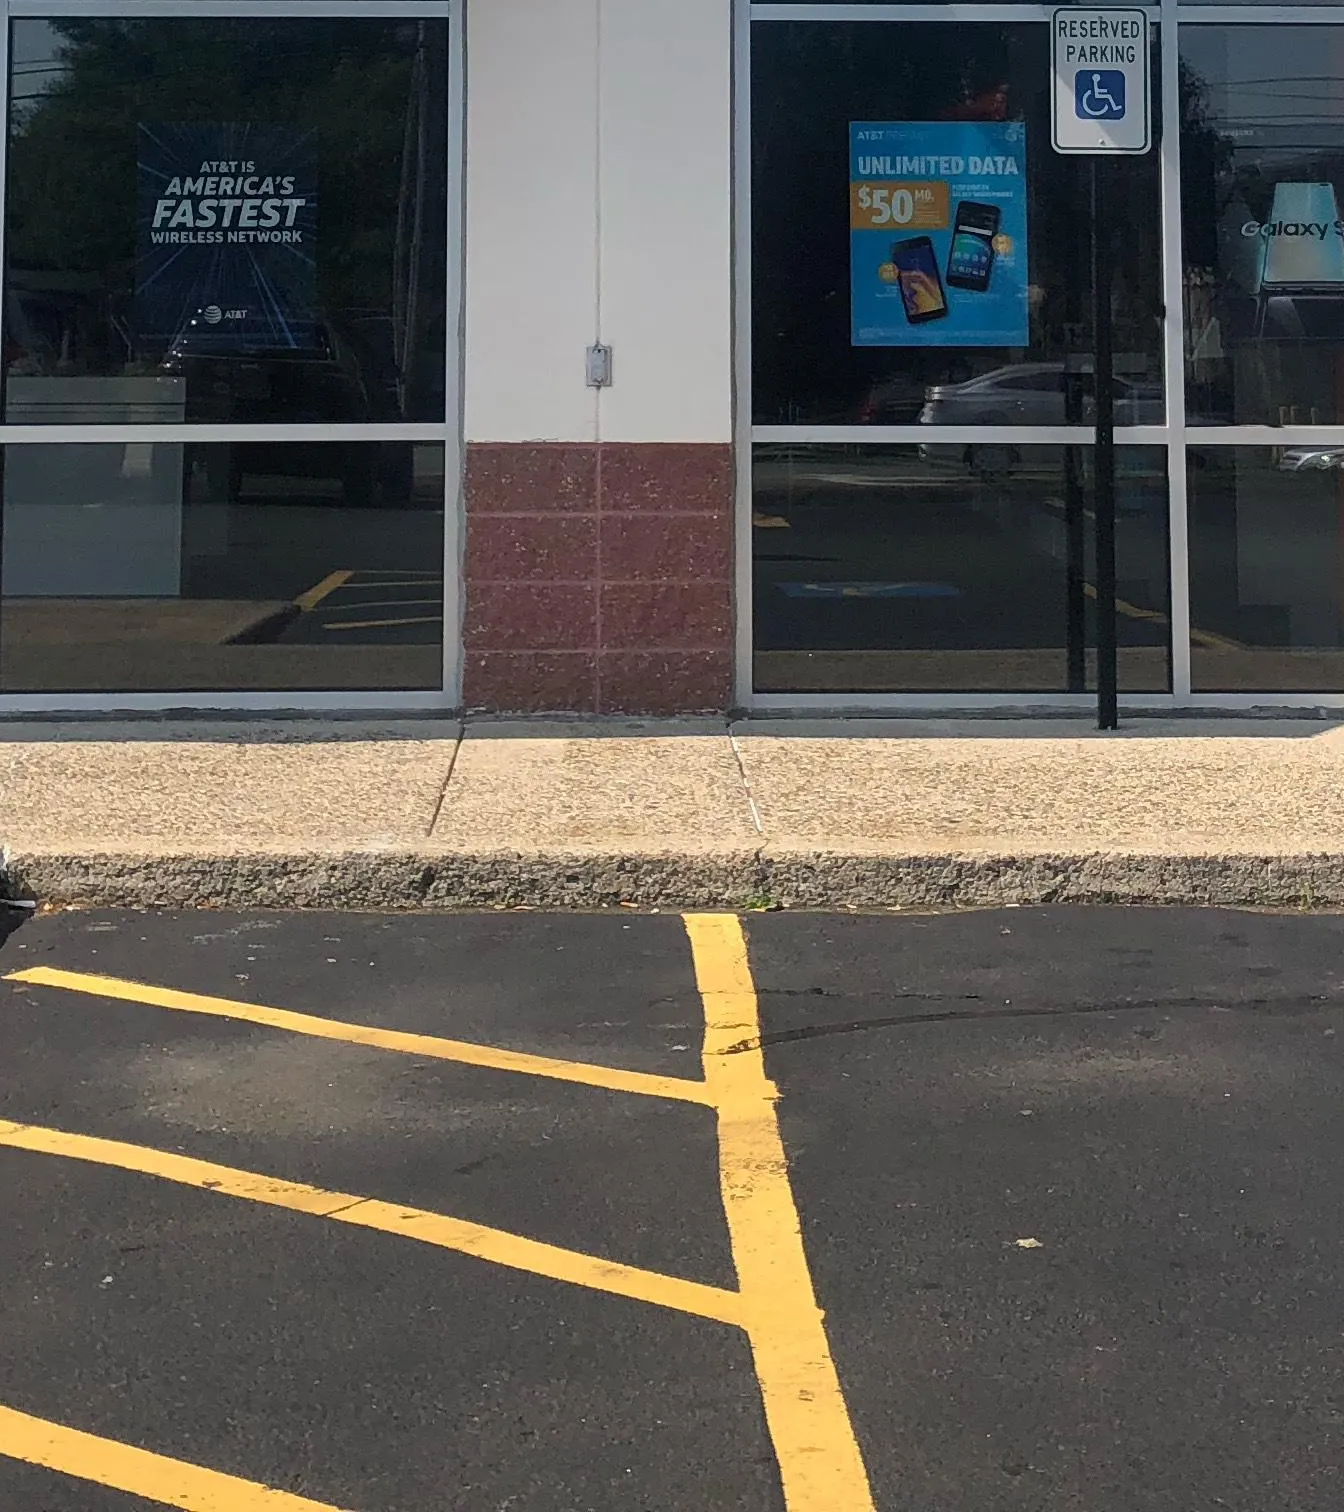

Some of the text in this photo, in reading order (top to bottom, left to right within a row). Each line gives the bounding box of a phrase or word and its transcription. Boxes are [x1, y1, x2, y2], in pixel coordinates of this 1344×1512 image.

[1058, 20, 1140, 39] RESERVED
[1066, 45, 1136, 64] PARKING
[857, 130, 885, 141] AT&T
[200, 160, 256, 174] AT&T IS
[858, 155, 1019, 176] UNLIMITED DATA
[164, 176, 296, 196] AMERICA'S
[151, 199, 306, 228] FASTEST
[858, 184, 914, 224] $50
[150, 230, 303, 244] WIRELESS NETWORK
[1240, 220, 1329, 240] Galaxy
[224, 310, 248, 319] AT&T
